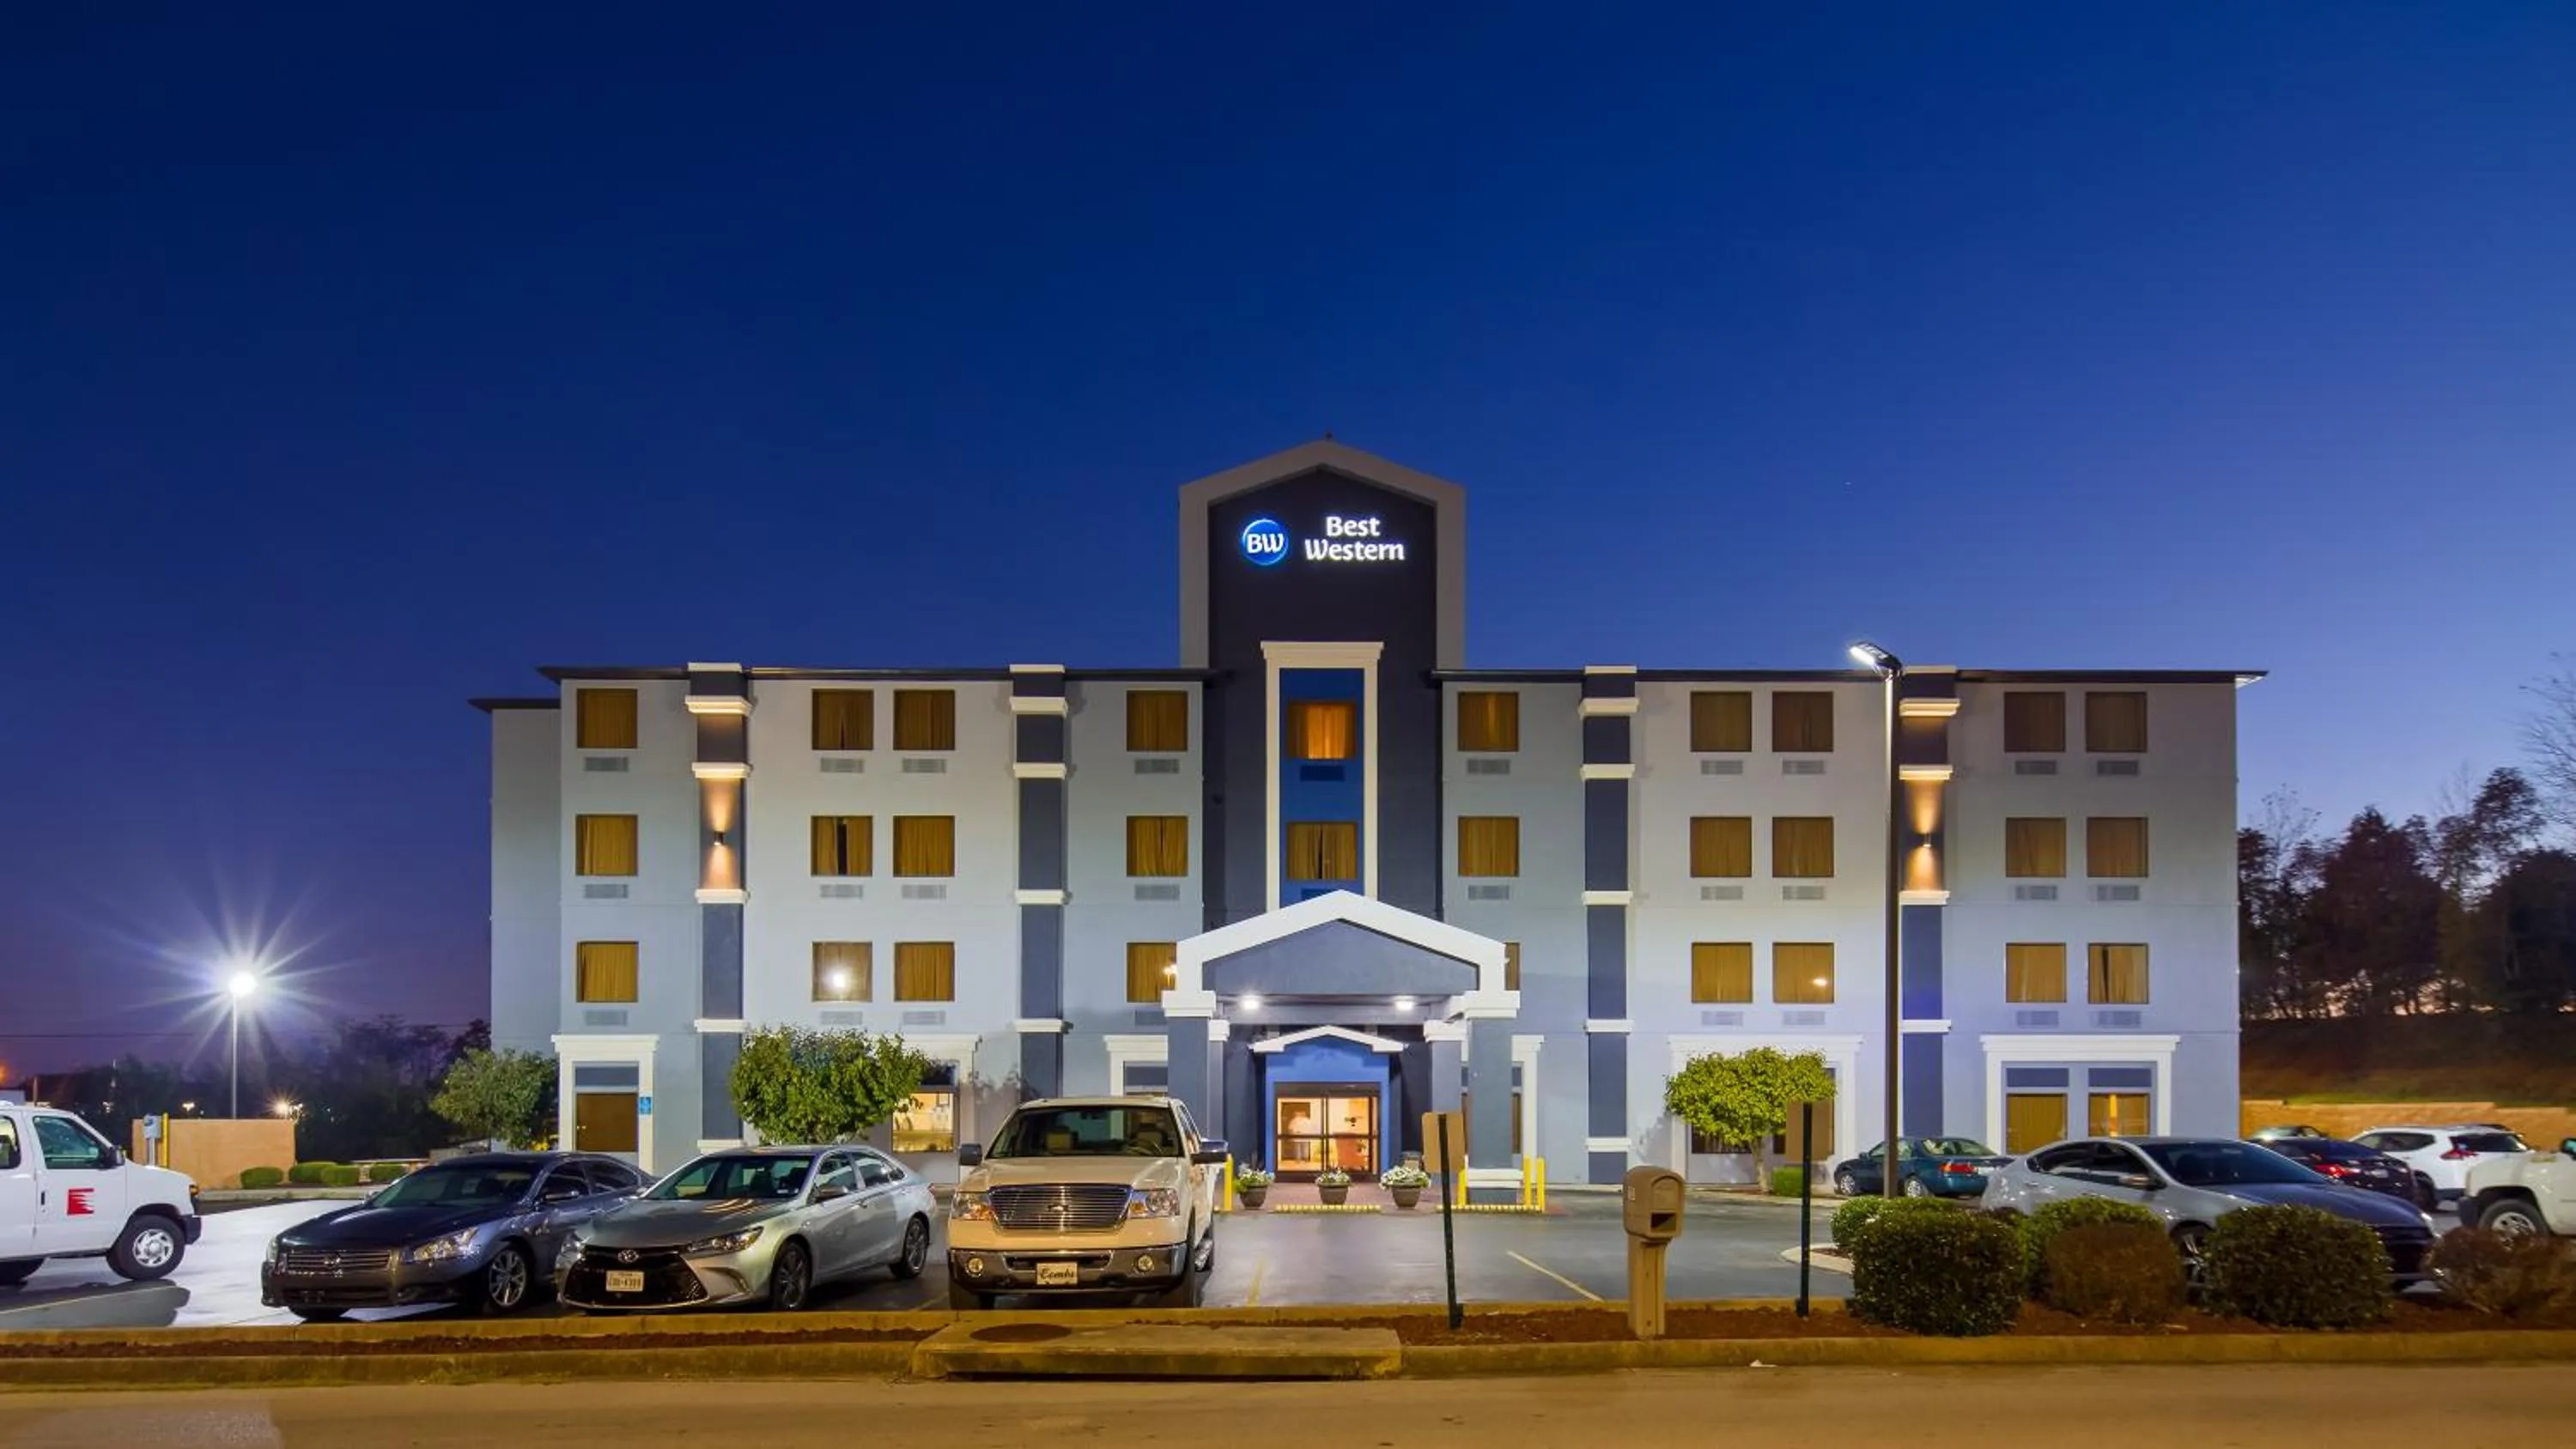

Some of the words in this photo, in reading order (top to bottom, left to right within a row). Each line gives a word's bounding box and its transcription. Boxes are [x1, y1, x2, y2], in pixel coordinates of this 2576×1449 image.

[1326, 516, 1380, 537] Best
[1247, 533, 1285, 554] BW
[1304, 538, 1405, 561] Western
